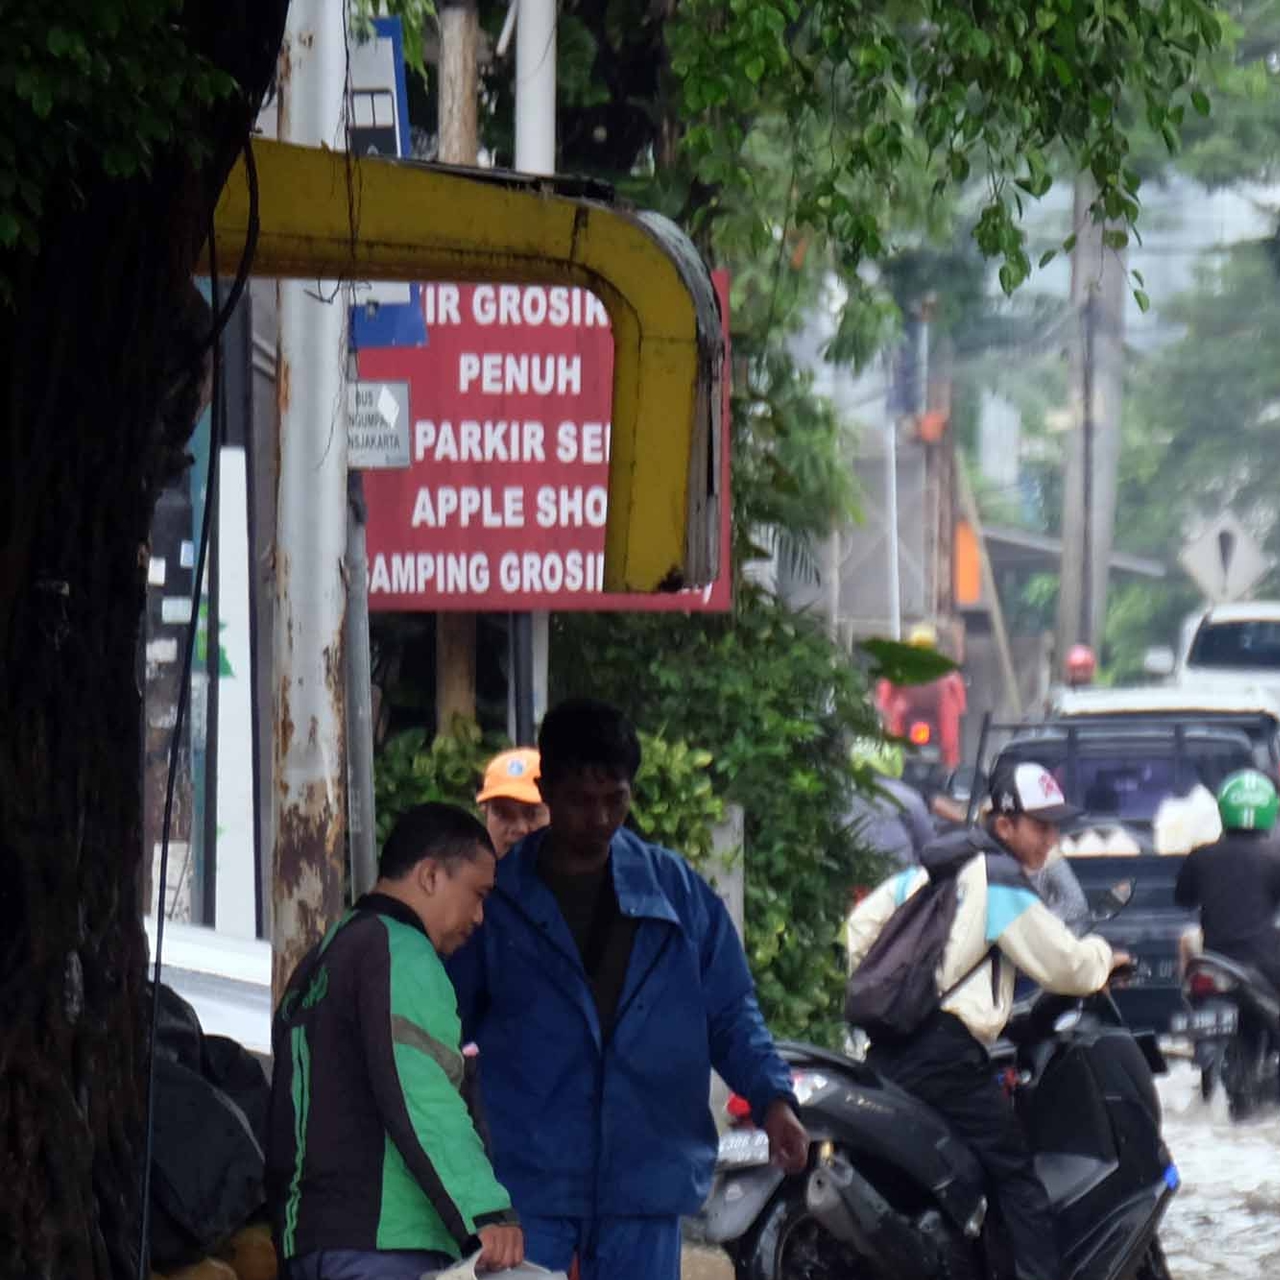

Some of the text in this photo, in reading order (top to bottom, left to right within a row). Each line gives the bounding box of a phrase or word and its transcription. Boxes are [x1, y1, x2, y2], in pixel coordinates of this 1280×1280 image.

[458, 352, 582, 394] PENUH
[414, 419, 546, 462] PARKIR
[411, 485, 525, 528] APPLE
[364, 552, 490, 594] AMPING
